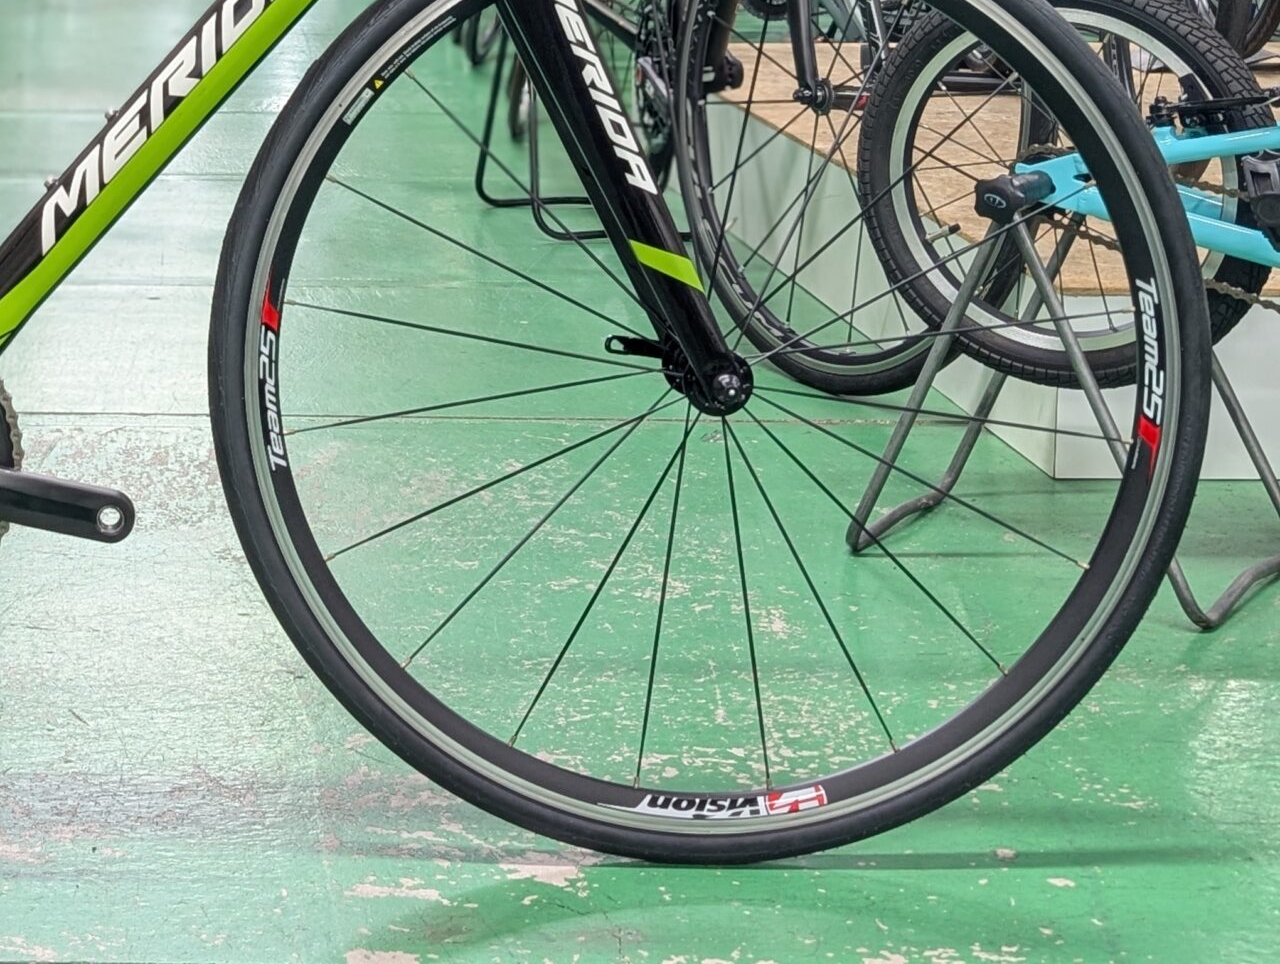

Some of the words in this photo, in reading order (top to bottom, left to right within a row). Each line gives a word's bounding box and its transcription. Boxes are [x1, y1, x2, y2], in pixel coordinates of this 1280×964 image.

[260, 324, 288, 472] Team25
[1135, 277, 1164, 425] Team25
[647, 794, 762, 816] Vision
